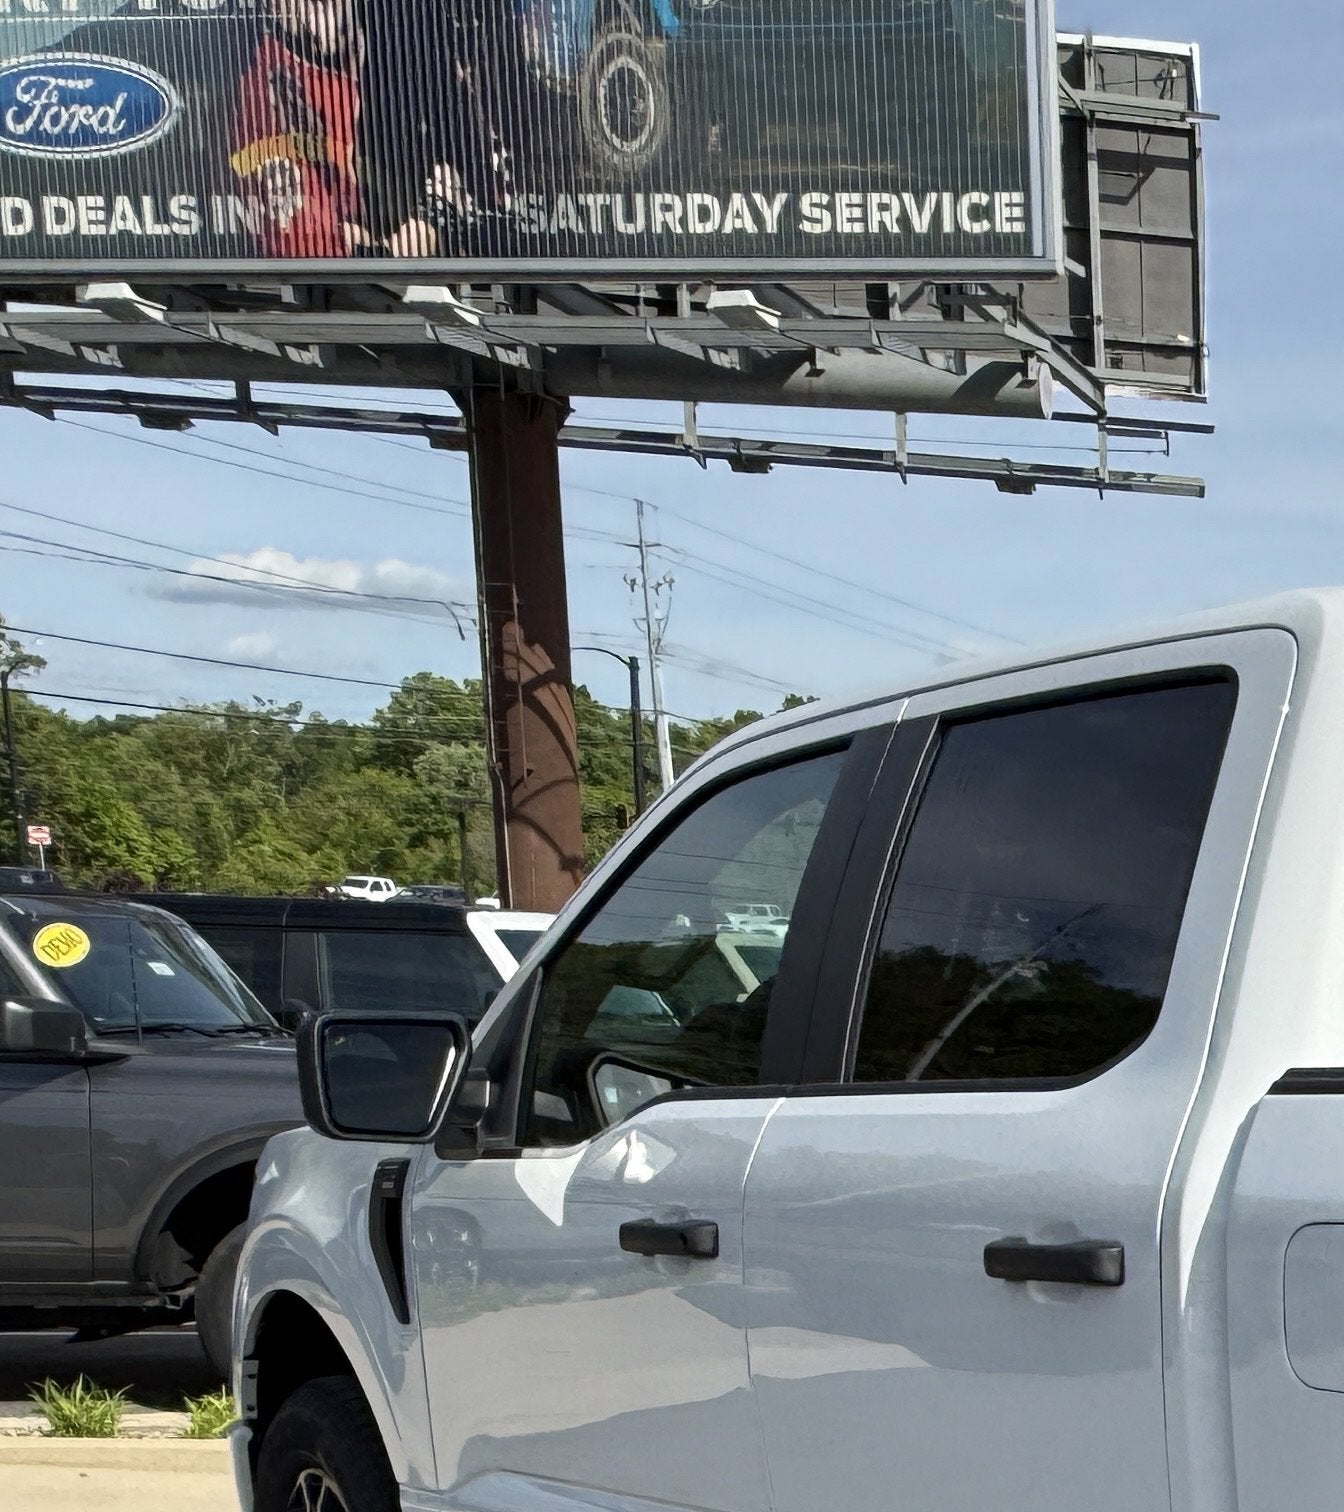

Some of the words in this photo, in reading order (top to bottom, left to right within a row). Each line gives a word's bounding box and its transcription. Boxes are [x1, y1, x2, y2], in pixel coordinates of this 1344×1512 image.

[5, 75, 128, 135] Ford
[42, 194, 201, 236] DEALS
[517, 191, 788, 235] SATURDAY
[799, 190, 1026, 234] SERVICE
